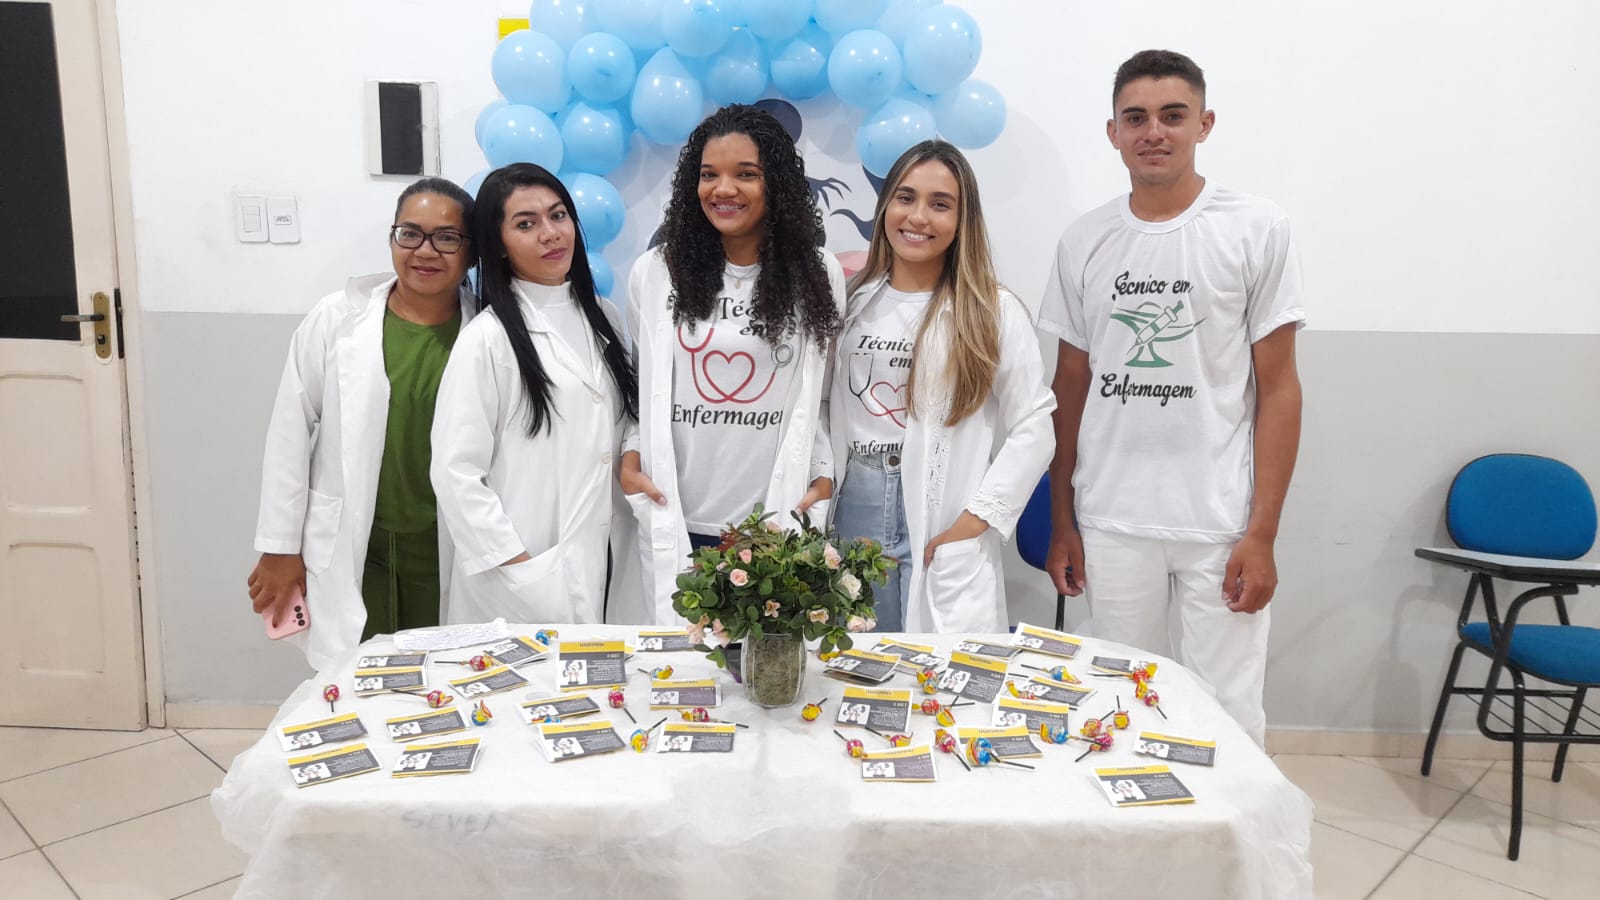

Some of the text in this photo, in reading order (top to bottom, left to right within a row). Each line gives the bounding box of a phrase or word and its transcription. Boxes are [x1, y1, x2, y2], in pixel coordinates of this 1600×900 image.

[857, 335, 914, 352] Técnic
[889, 356, 912, 368] em
[853, 440, 904, 454] Enferm
